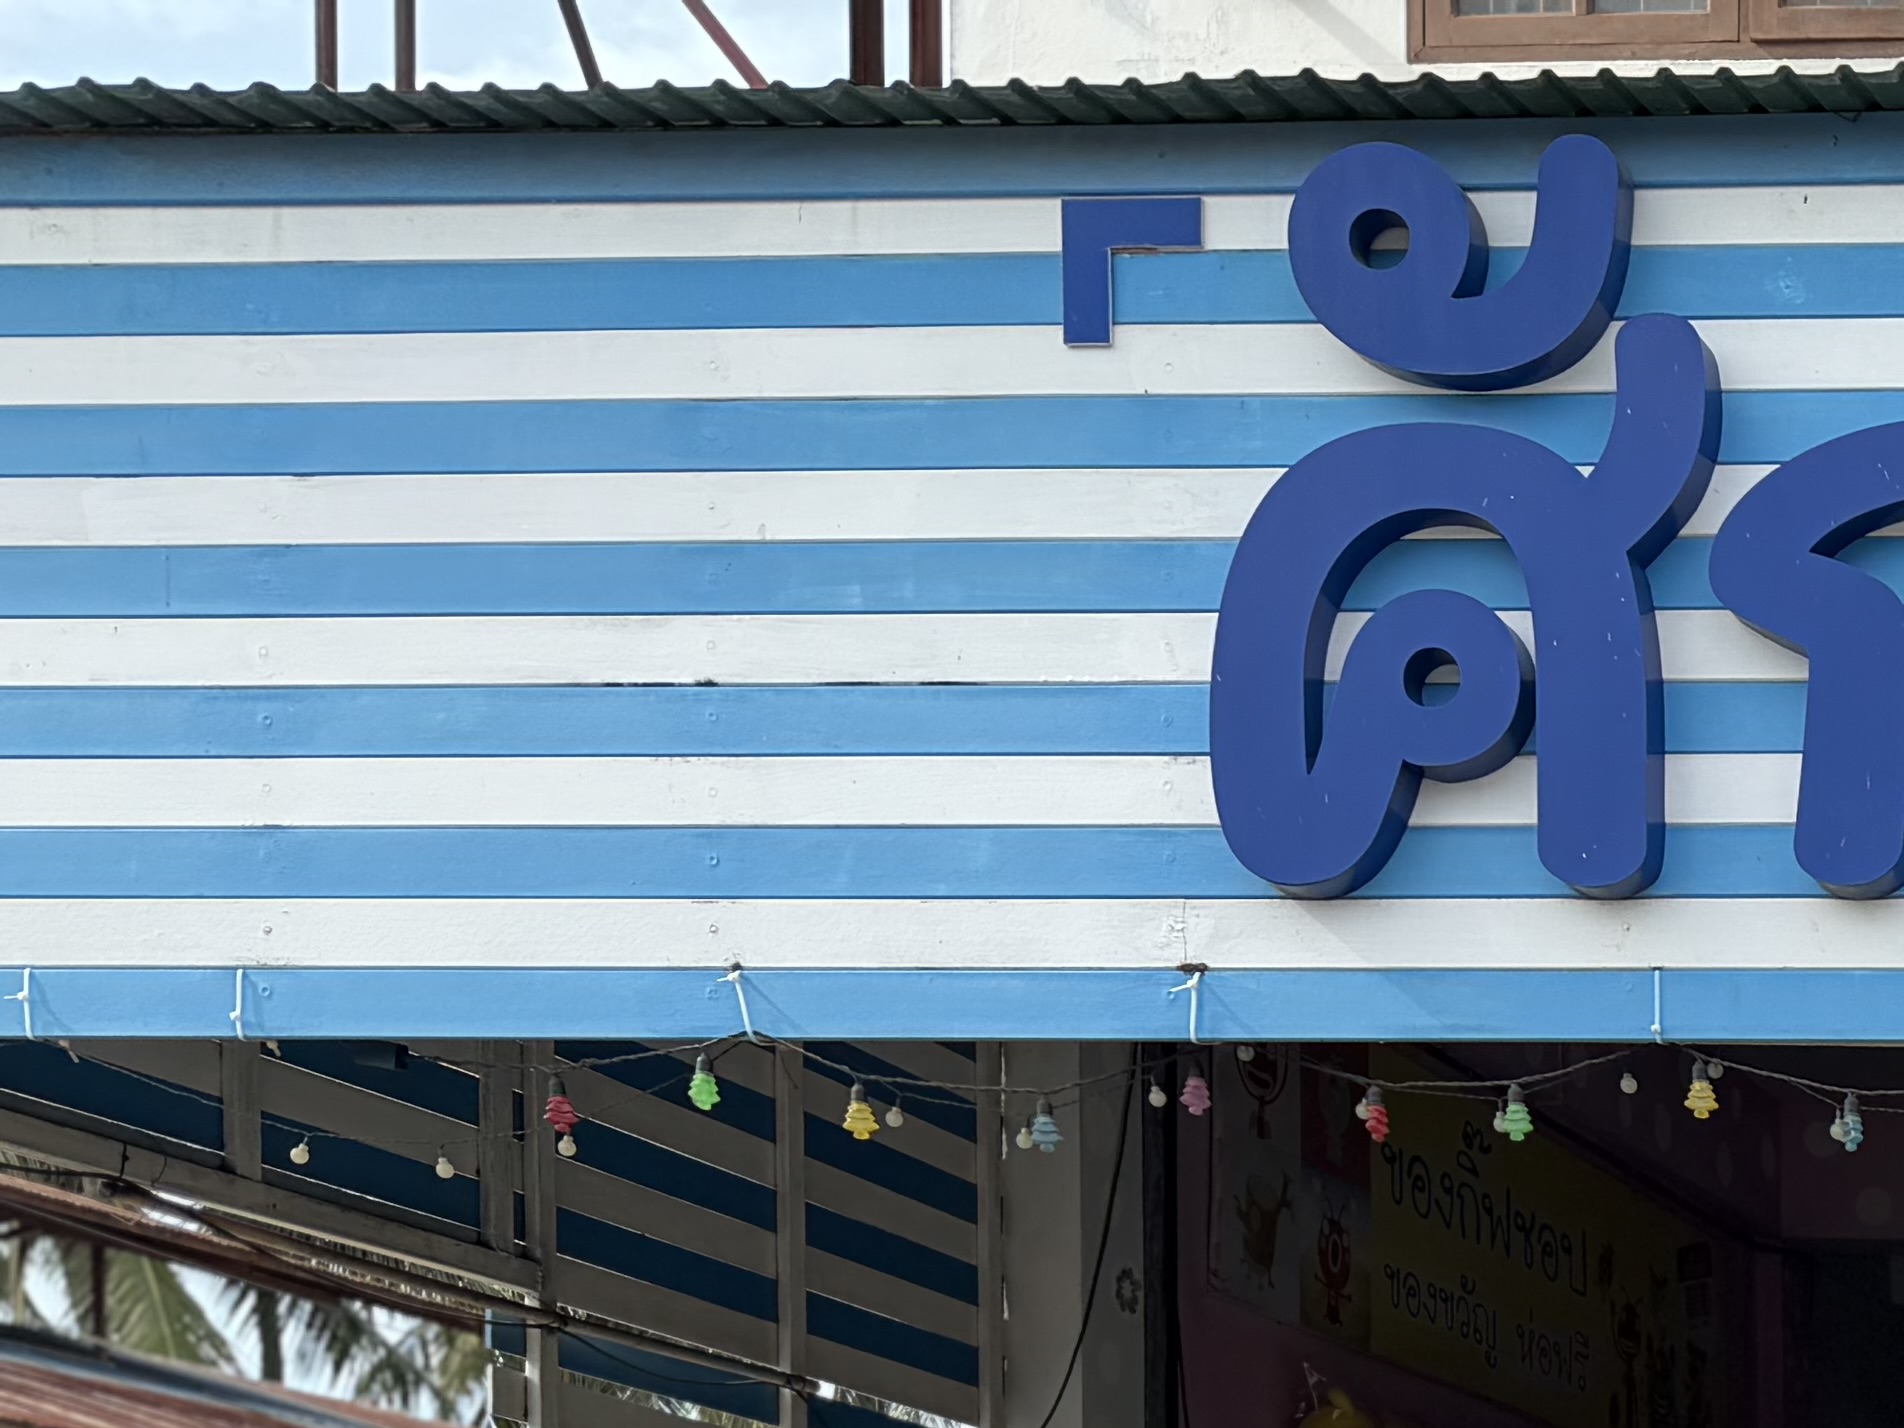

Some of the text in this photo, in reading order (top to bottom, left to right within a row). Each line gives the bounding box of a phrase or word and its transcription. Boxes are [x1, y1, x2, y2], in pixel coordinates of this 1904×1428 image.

[1383, 1262, 1590, 1392] ของขวัญ ห่อฟรี
